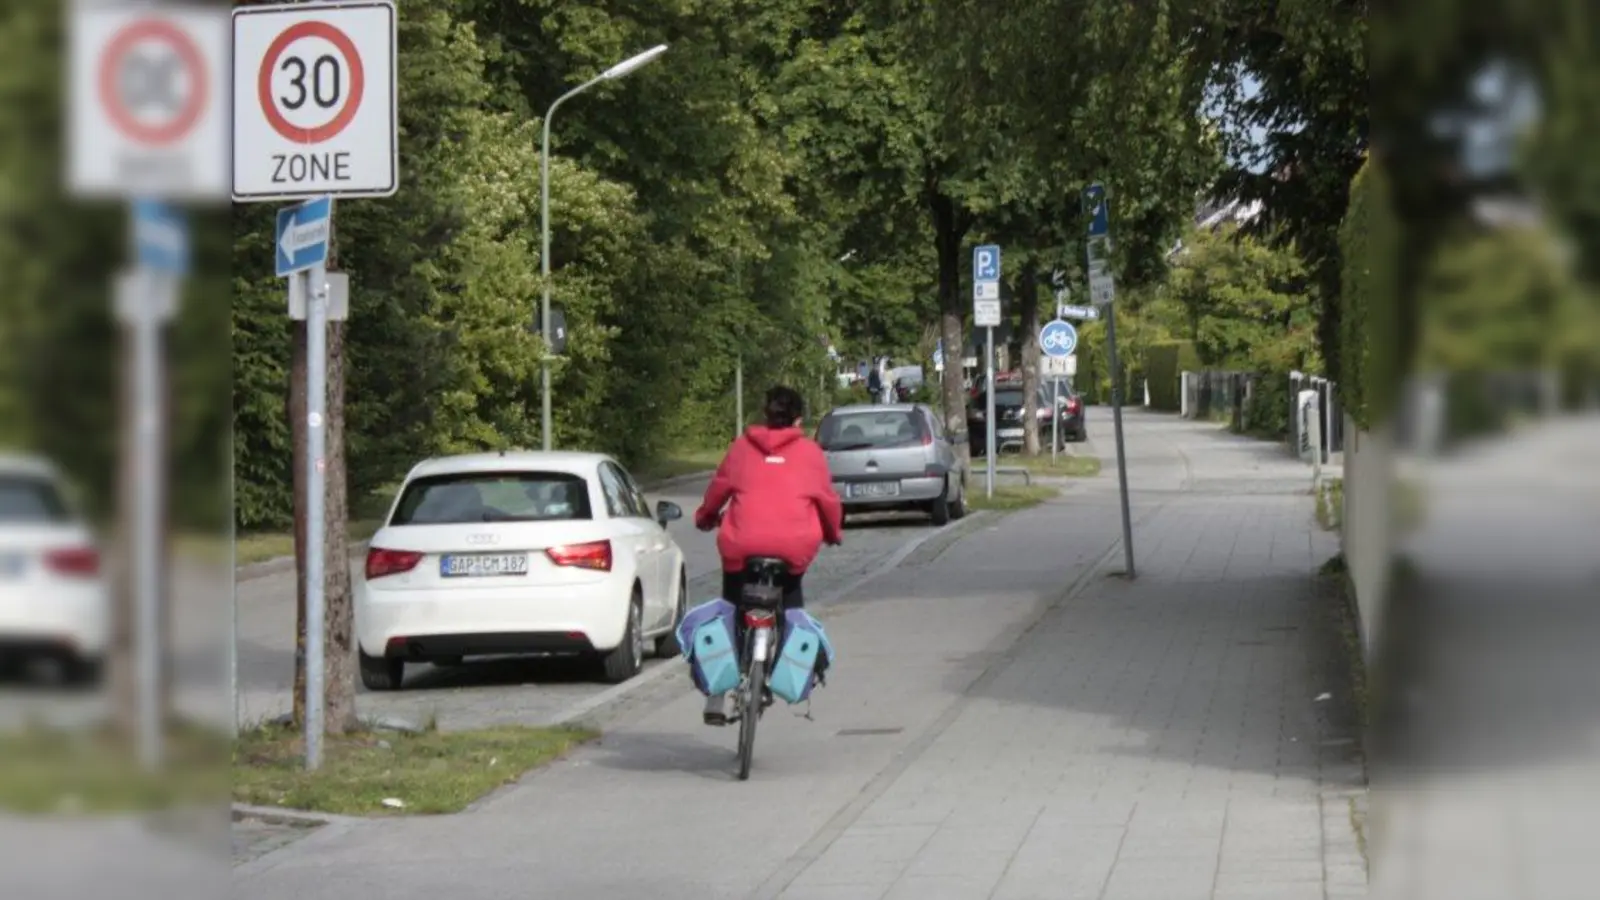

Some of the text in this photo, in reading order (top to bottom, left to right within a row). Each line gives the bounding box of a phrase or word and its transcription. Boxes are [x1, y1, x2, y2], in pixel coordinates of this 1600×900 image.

[280, 54, 341, 110] 30
[271, 152, 351, 183] ZONE
[978, 250, 992, 277] P
